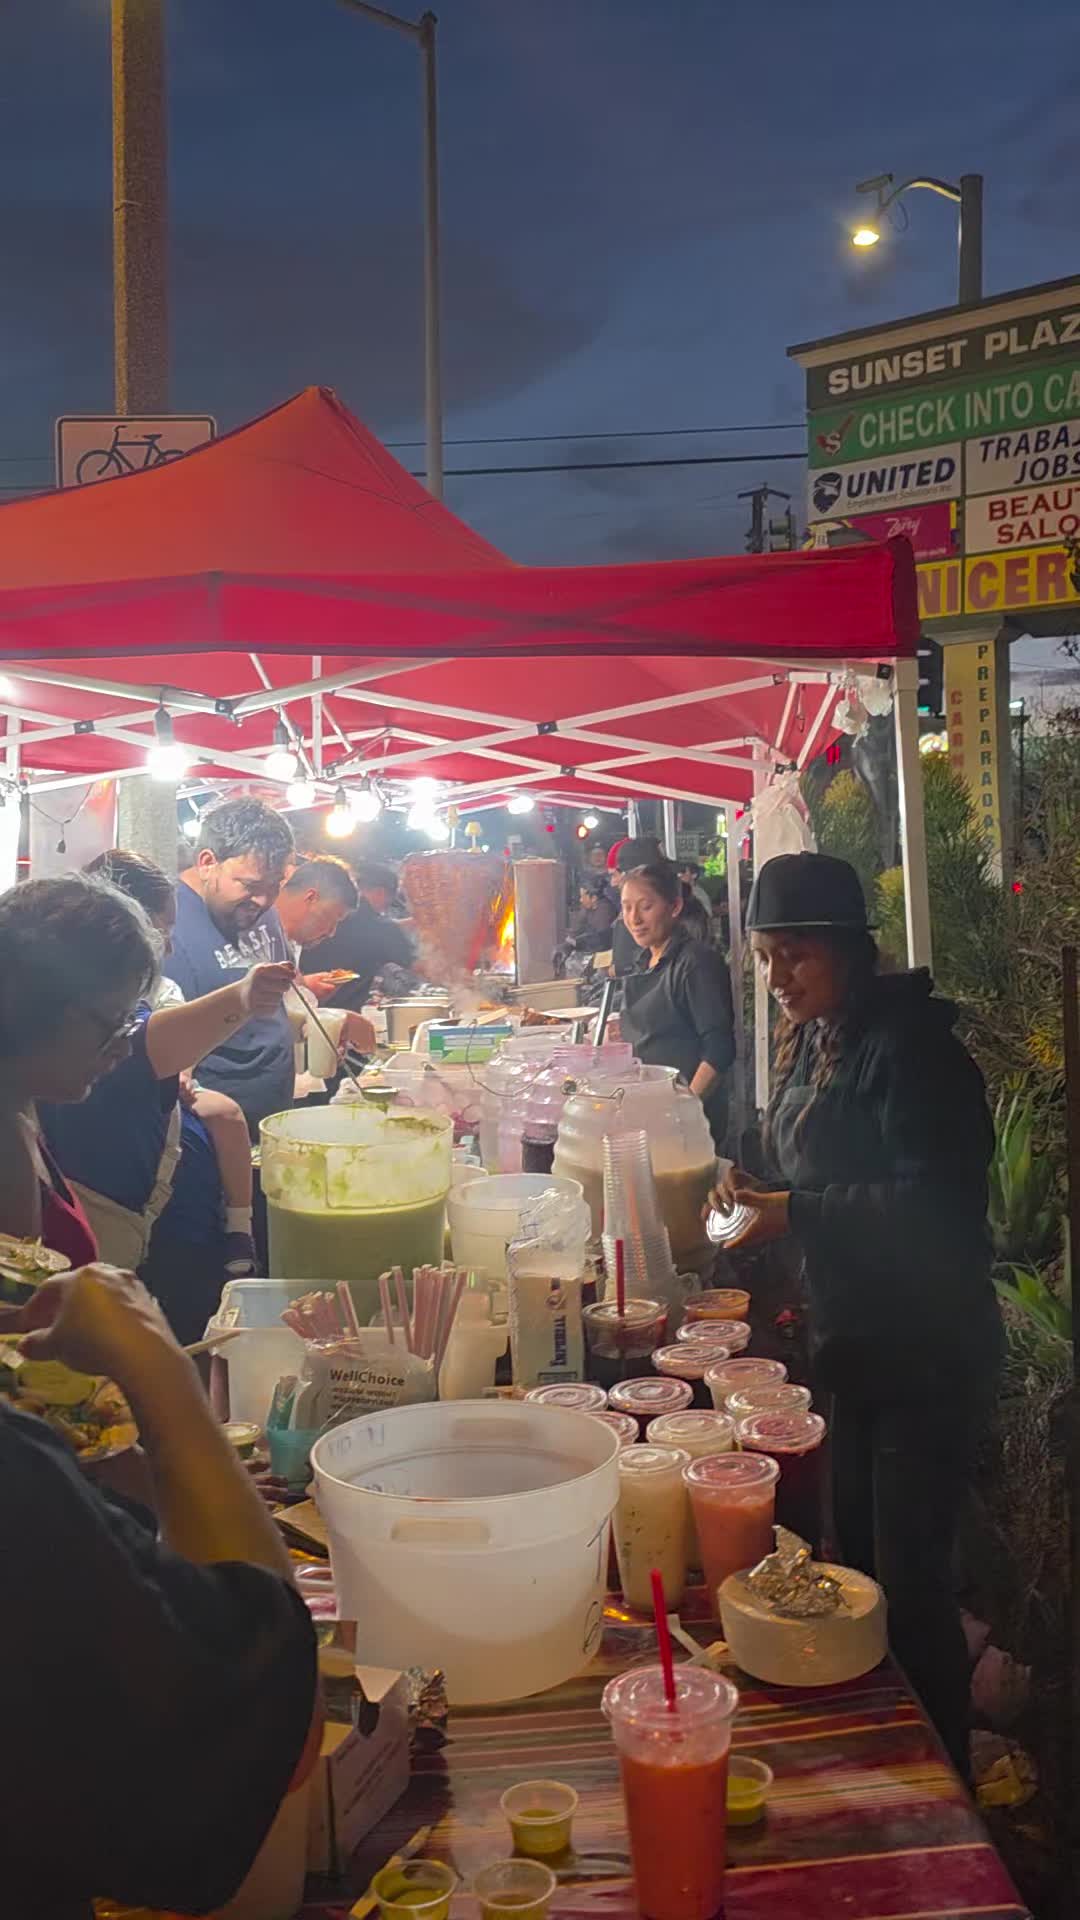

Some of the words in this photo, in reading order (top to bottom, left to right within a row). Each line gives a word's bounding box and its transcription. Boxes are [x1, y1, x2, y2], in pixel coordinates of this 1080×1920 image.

[828, 339, 969, 395] SUNSET
[859, 395, 956, 449] CHECK
[965, 380, 1034, 430] INTO
[847, 456, 956, 499] UNITED
[330, 1369, 405, 1386] WellChoice
